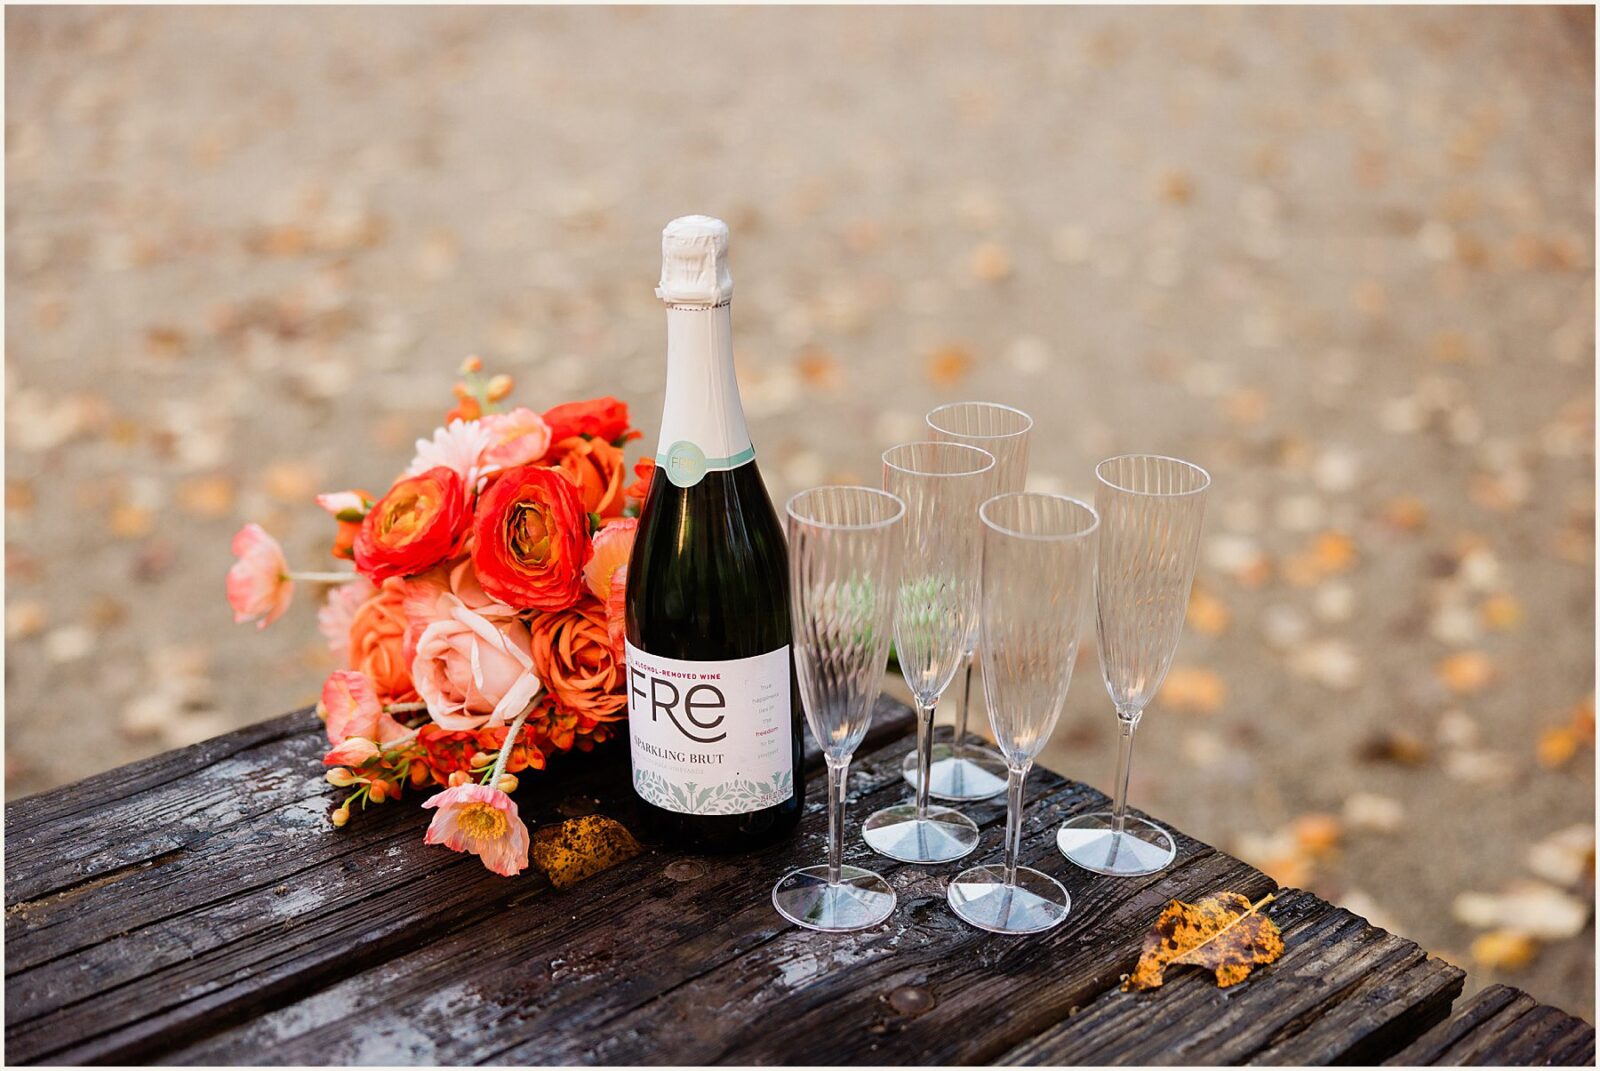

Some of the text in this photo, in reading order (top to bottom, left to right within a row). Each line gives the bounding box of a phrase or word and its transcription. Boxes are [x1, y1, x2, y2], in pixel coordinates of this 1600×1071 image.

[635, 660, 697, 680] ALCOHOL-REMOVED
[755, 726, 779, 737] freedom
[633, 735, 686, 763] SPARKLING
[689, 753, 725, 764] BRUT
